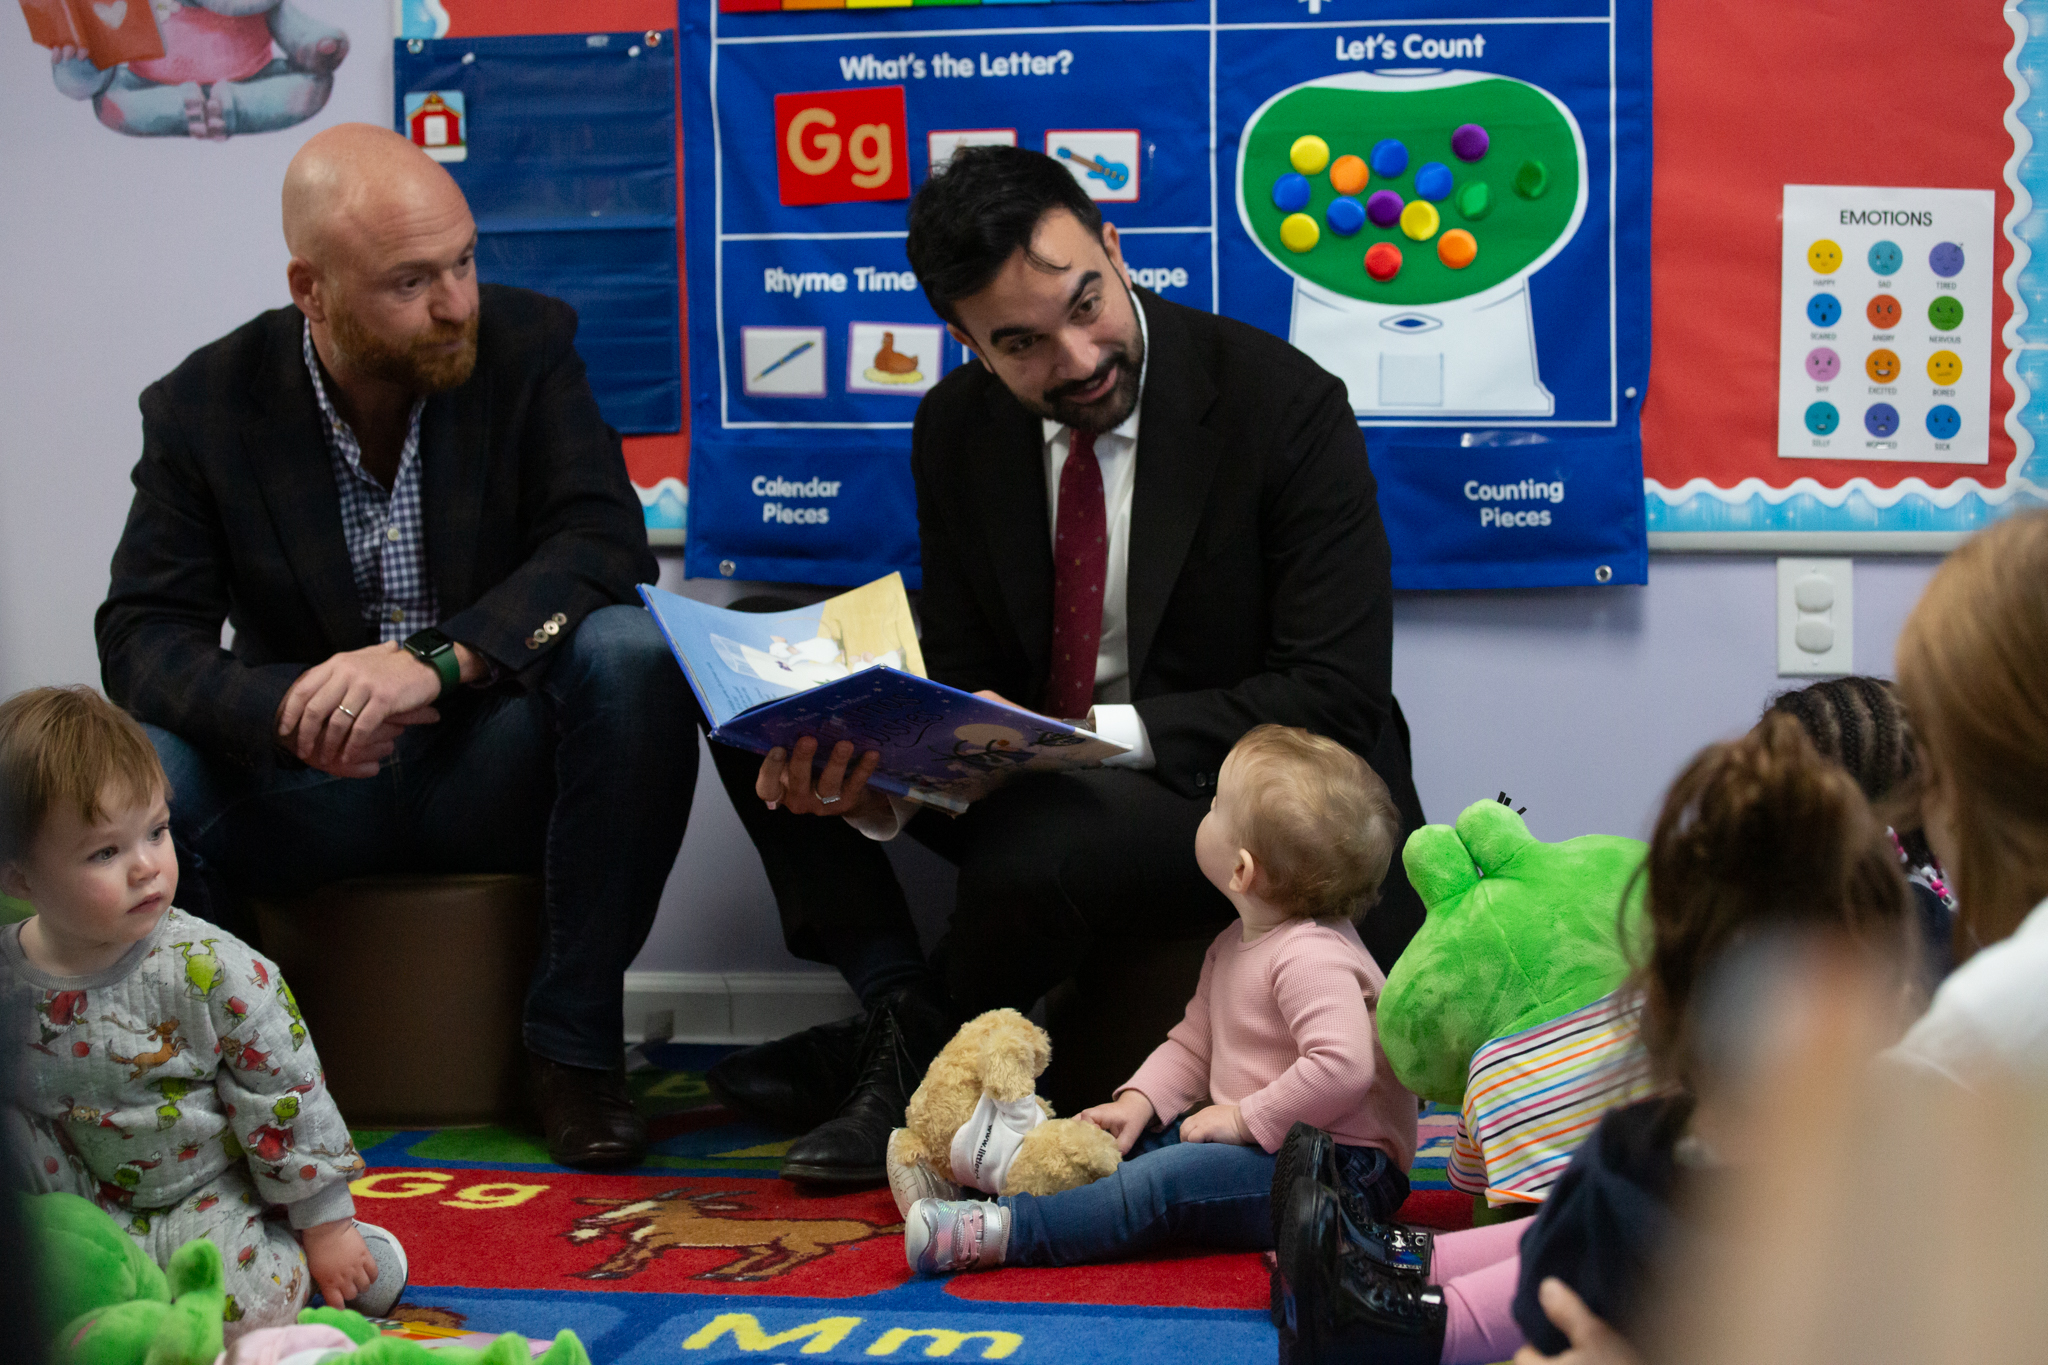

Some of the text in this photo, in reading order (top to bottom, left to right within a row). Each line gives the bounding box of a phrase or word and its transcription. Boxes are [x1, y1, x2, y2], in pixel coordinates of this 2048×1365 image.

[1335, 33, 1486, 61] Let's Count
[839, 49, 1074, 81] What's the Letter?
[786, 107, 893, 189] Gg
[1840, 209, 1933, 228] EMOTIONS
[764, 265, 918, 299] Rhyme Time
[1124, 261, 1189, 294] hape
[1813, 278, 1836, 287] HAPPY
[1878, 280, 1892, 289] SAD
[1936, 282, 1957, 291] TIRED
[1810, 332, 1837, 341] SCARED
[1872, 334, 1895, 343] ANGRY
[1929, 335, 1961, 345] NERVOUS
[1815, 385, 1830, 394] SHY
[1868, 387, 1898, 396] EXCITED
[1932, 388, 1956, 398] BORED
[1812, 438, 1831, 448] SILLY
[1934, 442, 1951, 452] SICK
[751, 475, 842, 498] Calendar
[1464, 478, 1565, 504] Counting
[762, 502, 830, 525] Pieces
[1480, 506, 1552, 528] Pieces
[349, 1171, 551, 1210] Gg
[682, 1312, 1024, 1359] Mm
